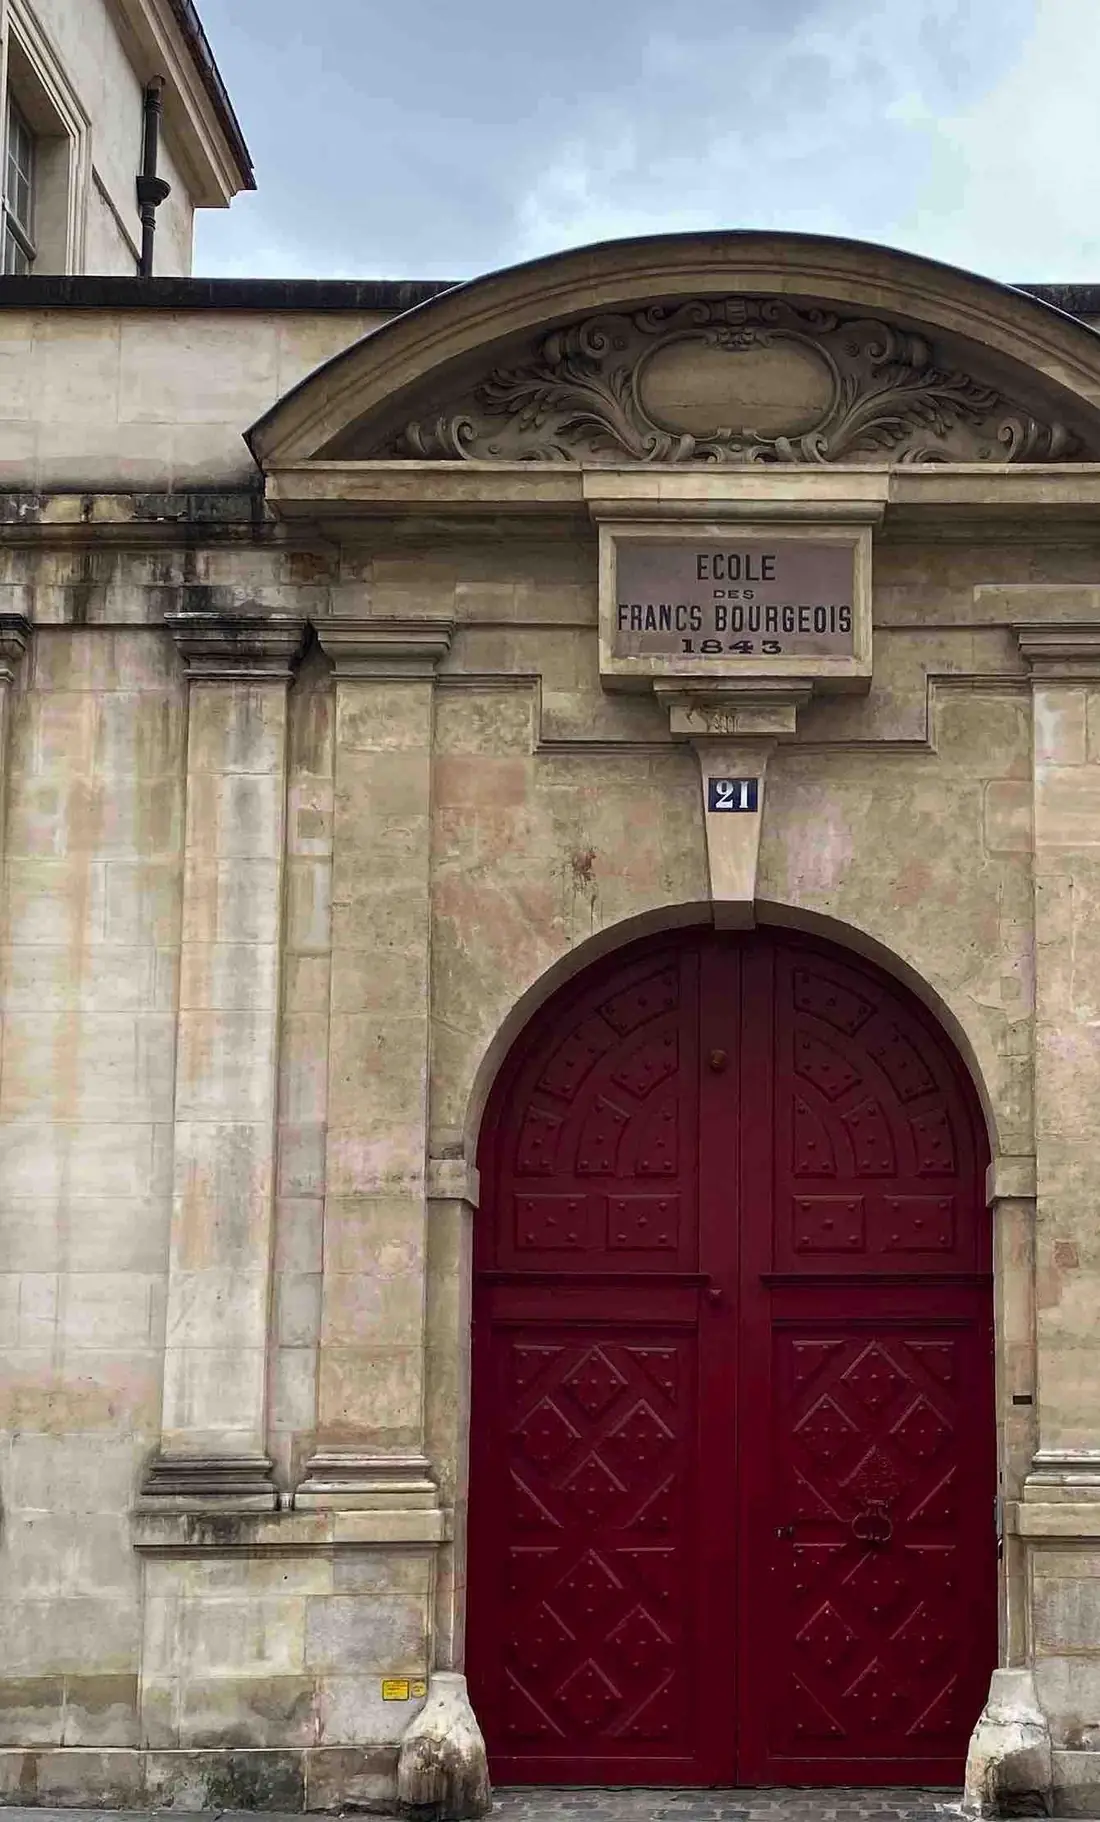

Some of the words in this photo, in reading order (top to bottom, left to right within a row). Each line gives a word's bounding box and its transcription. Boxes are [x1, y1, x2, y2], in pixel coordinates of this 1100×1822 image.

[696, 554, 776, 581] ECOLE
[712, 589, 755, 600] DES
[617, 604, 702, 632] FRANCS
[714, 605, 851, 633] BOURGEOIS
[681, 638, 782, 655] 1843
[715, 780, 750, 809] 21
